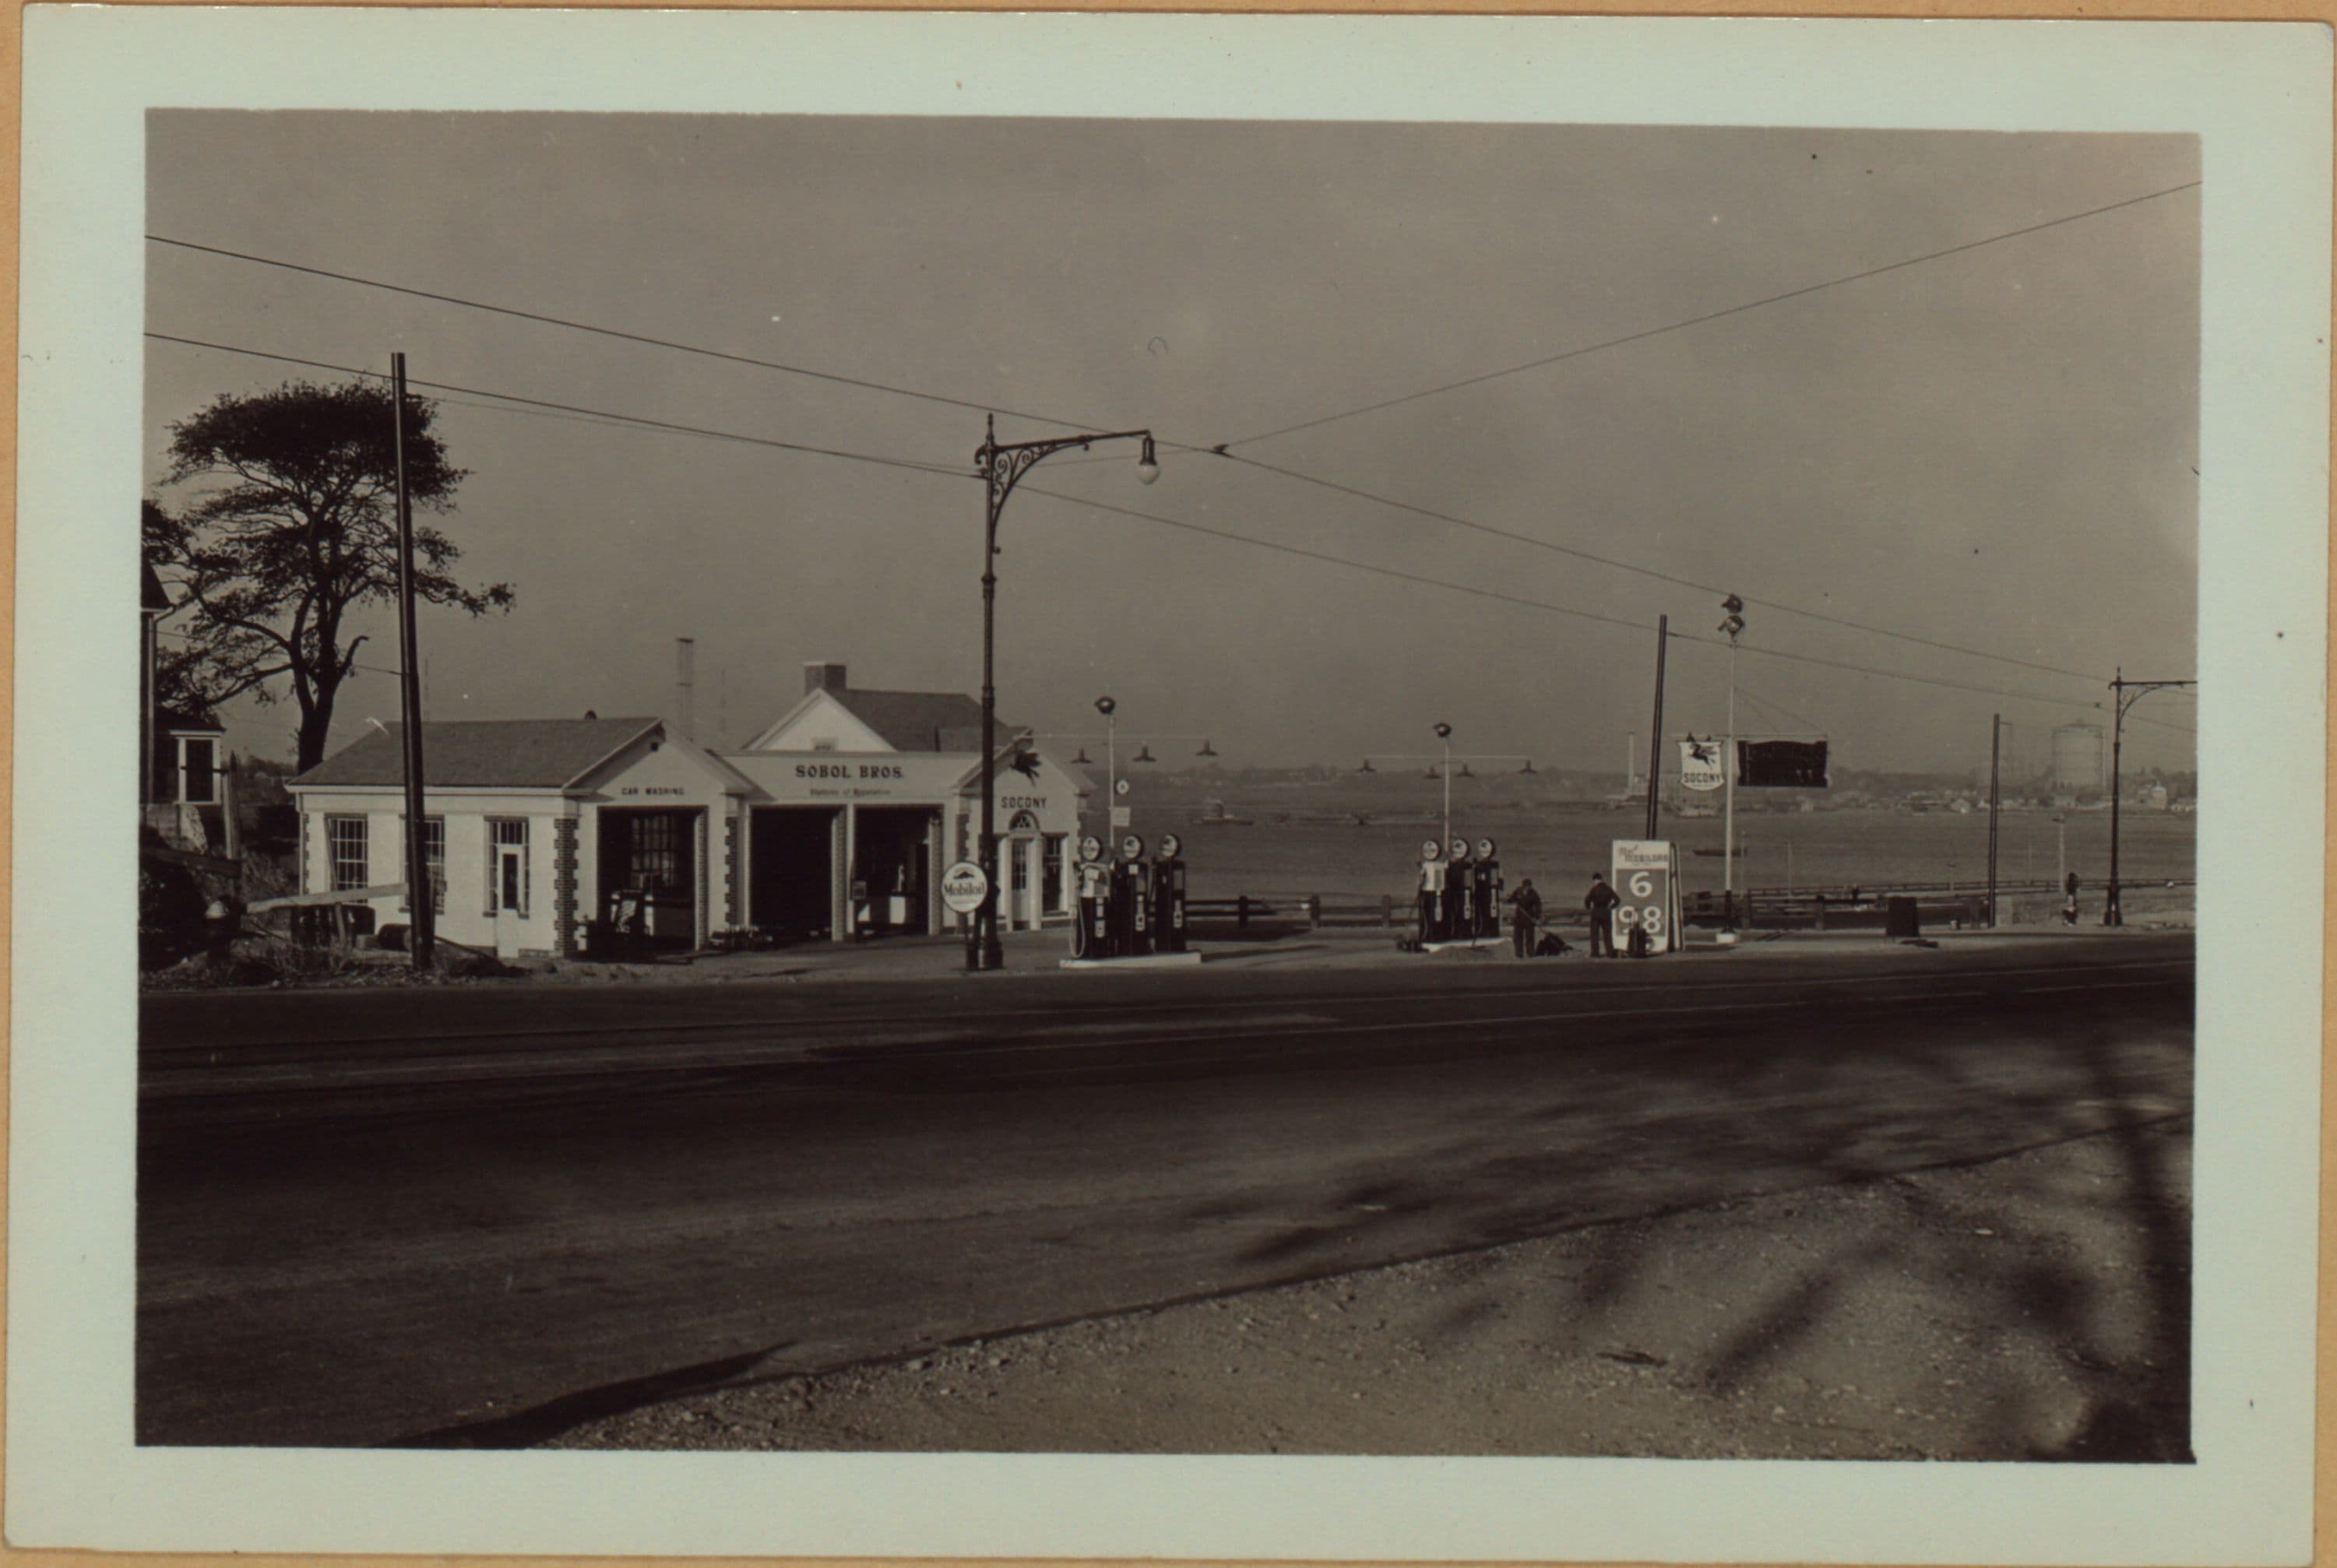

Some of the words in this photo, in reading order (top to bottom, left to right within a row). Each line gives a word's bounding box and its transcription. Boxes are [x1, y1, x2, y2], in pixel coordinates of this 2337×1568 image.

[795, 765, 851, 779] SOBOL
[1683, 772, 1721, 783] SOCONY
[1001, 796, 1047, 809] SOCONY
[944, 881, 985, 897] Mobiloil
[1629, 871, 1652, 897] 6
[1618, 905, 1661, 934] 98
